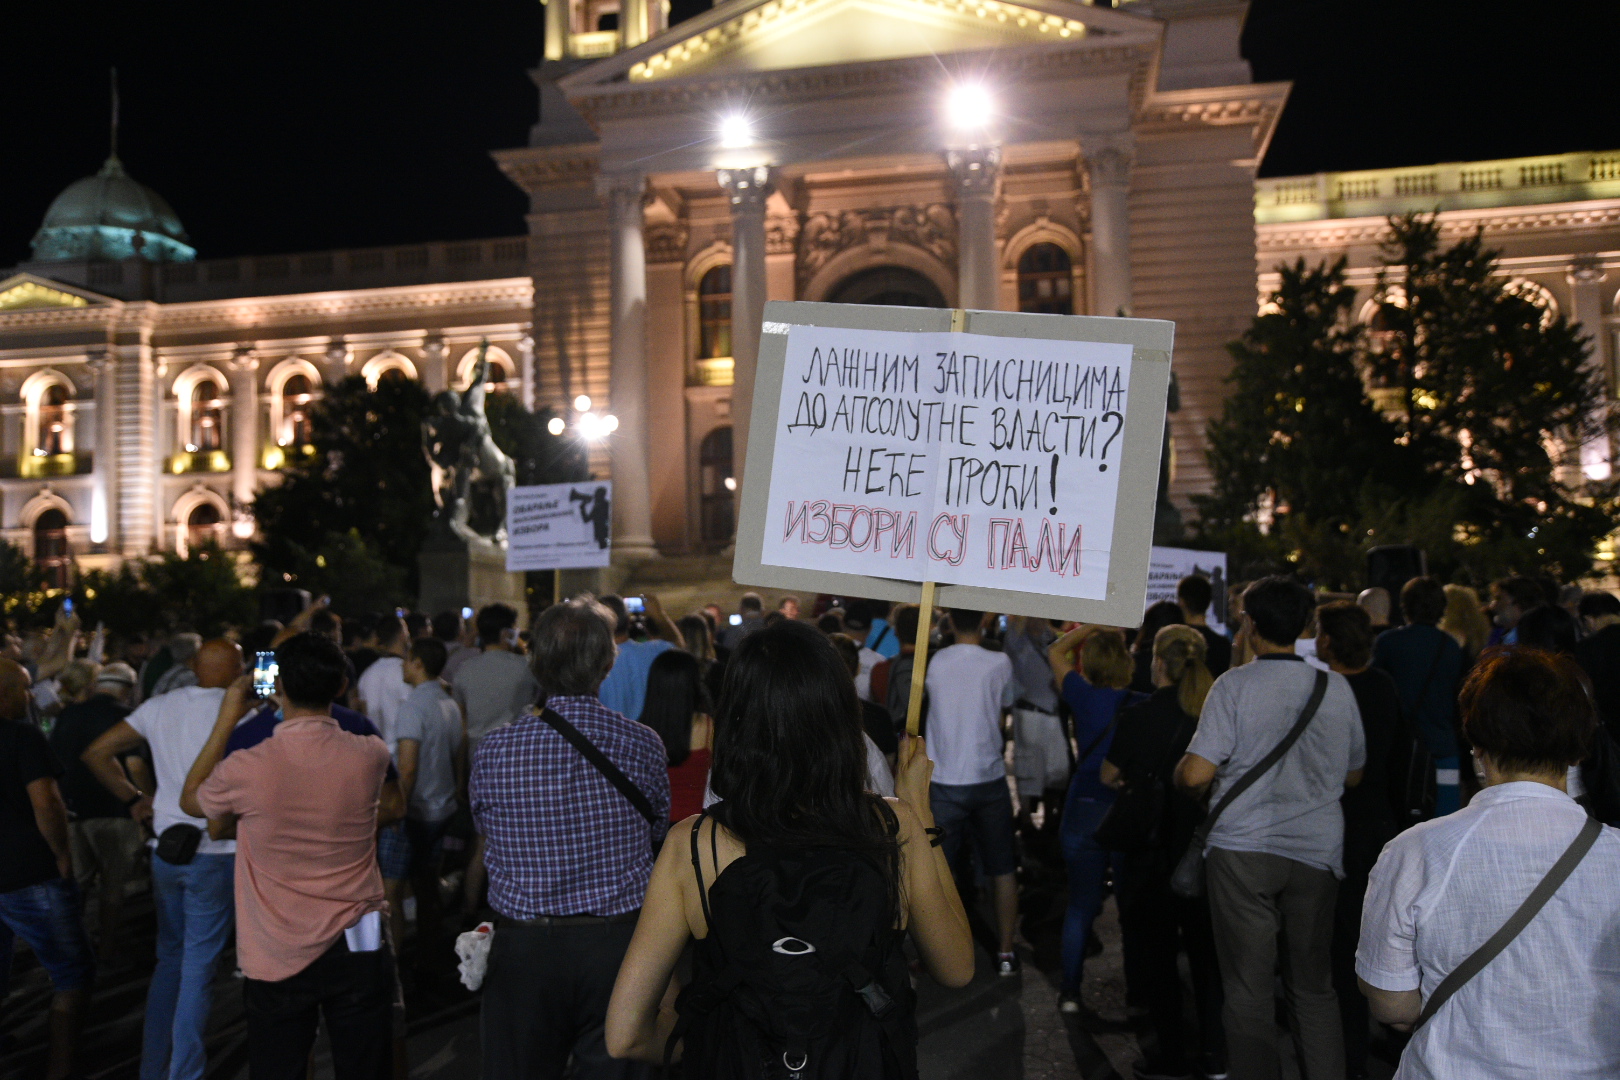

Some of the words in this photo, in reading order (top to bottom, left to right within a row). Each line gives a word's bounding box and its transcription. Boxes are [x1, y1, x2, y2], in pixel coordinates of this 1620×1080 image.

[802, 346, 919, 393] ЛАЖНИМ
[933, 351, 1126, 413] ЗАПИСНИЦИМА
[787, 391, 827, 437] ДО
[831, 393, 979, 446] АПСОЛУТНЕ
[989, 406, 1124, 473] ВЛАСТИ?
[843, 446, 926, 497] НЕЋЕ
[945, 453, 1060, 515] ПРОЋИ!
[783, 499, 918, 559] ИЗБОРИ
[927, 511, 970, 567] СУ
[987, 517, 1082, 578] ПАЛИ
